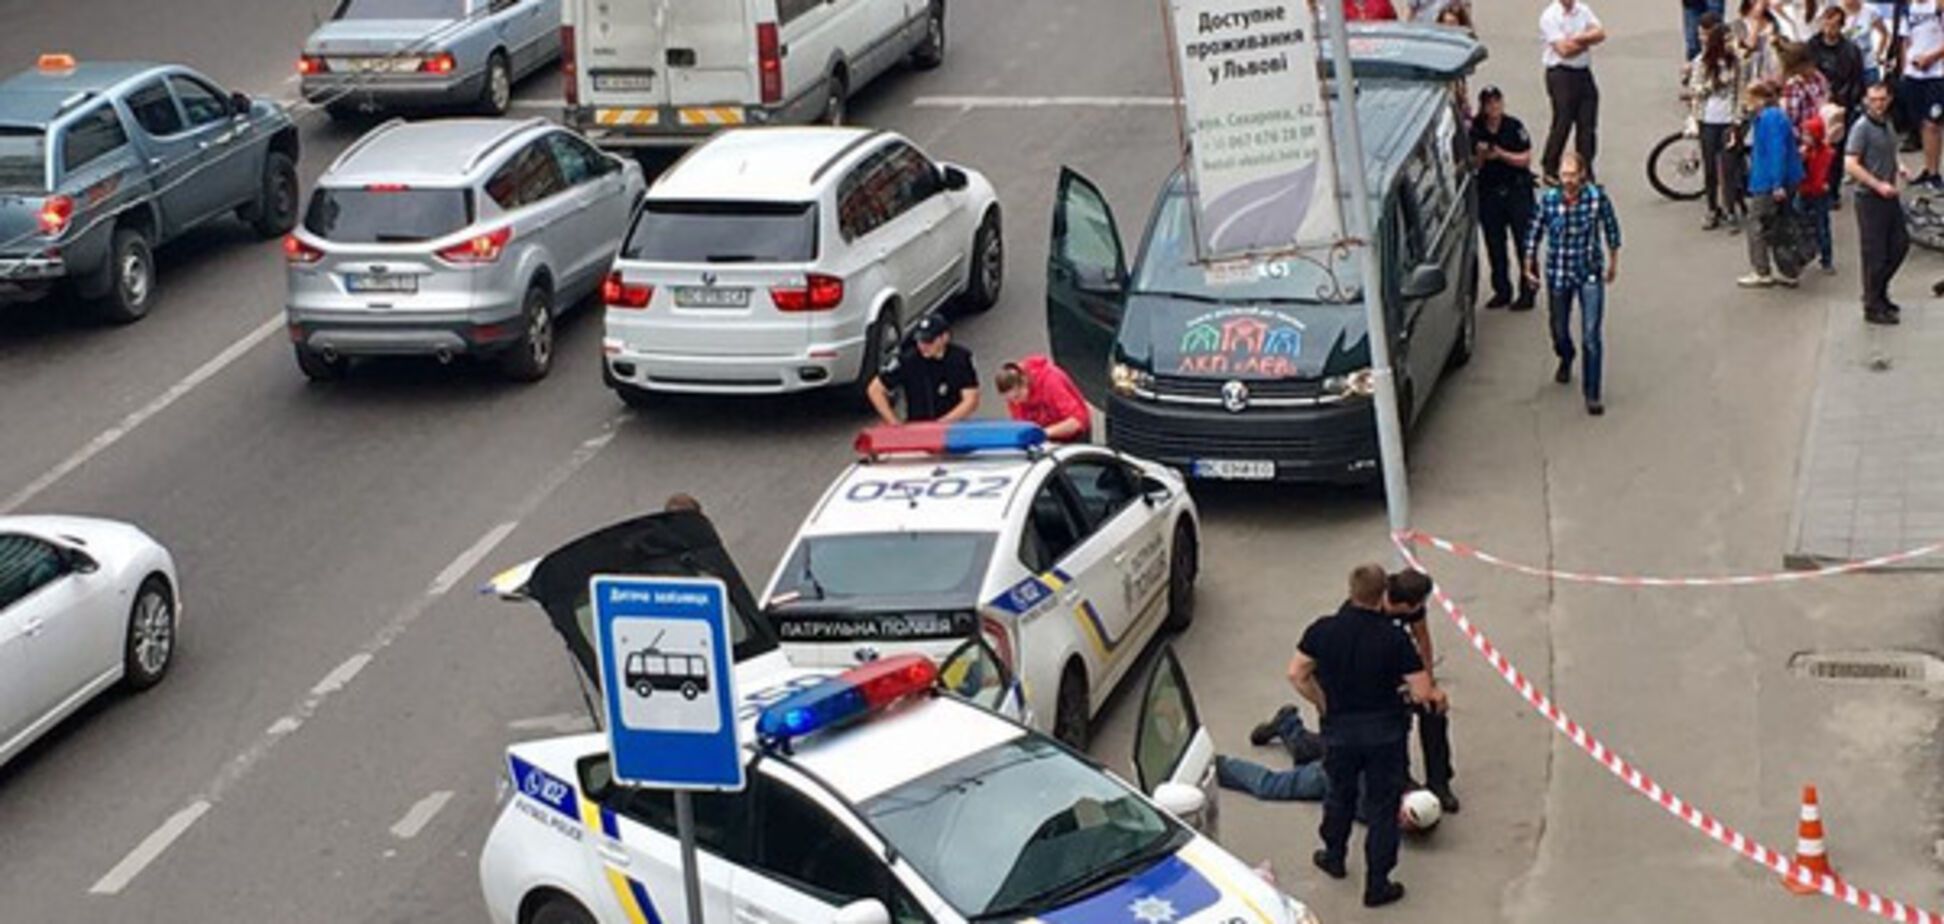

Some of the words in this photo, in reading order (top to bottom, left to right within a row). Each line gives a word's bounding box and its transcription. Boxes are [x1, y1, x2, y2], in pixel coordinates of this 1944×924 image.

[1199, 6, 1285, 33] Доступне
[1186, 29, 1304, 61] проживання
[1209, 67, 1220, 85] у
[1225, 53, 1288, 79] Львові
[847, 476, 1012, 502] 0502
[780, 621, 878, 637] ПАТРУЛЬНА
[880, 618, 951, 636] ПОЛІЦІЯ
[541, 780, 569, 806] 102
